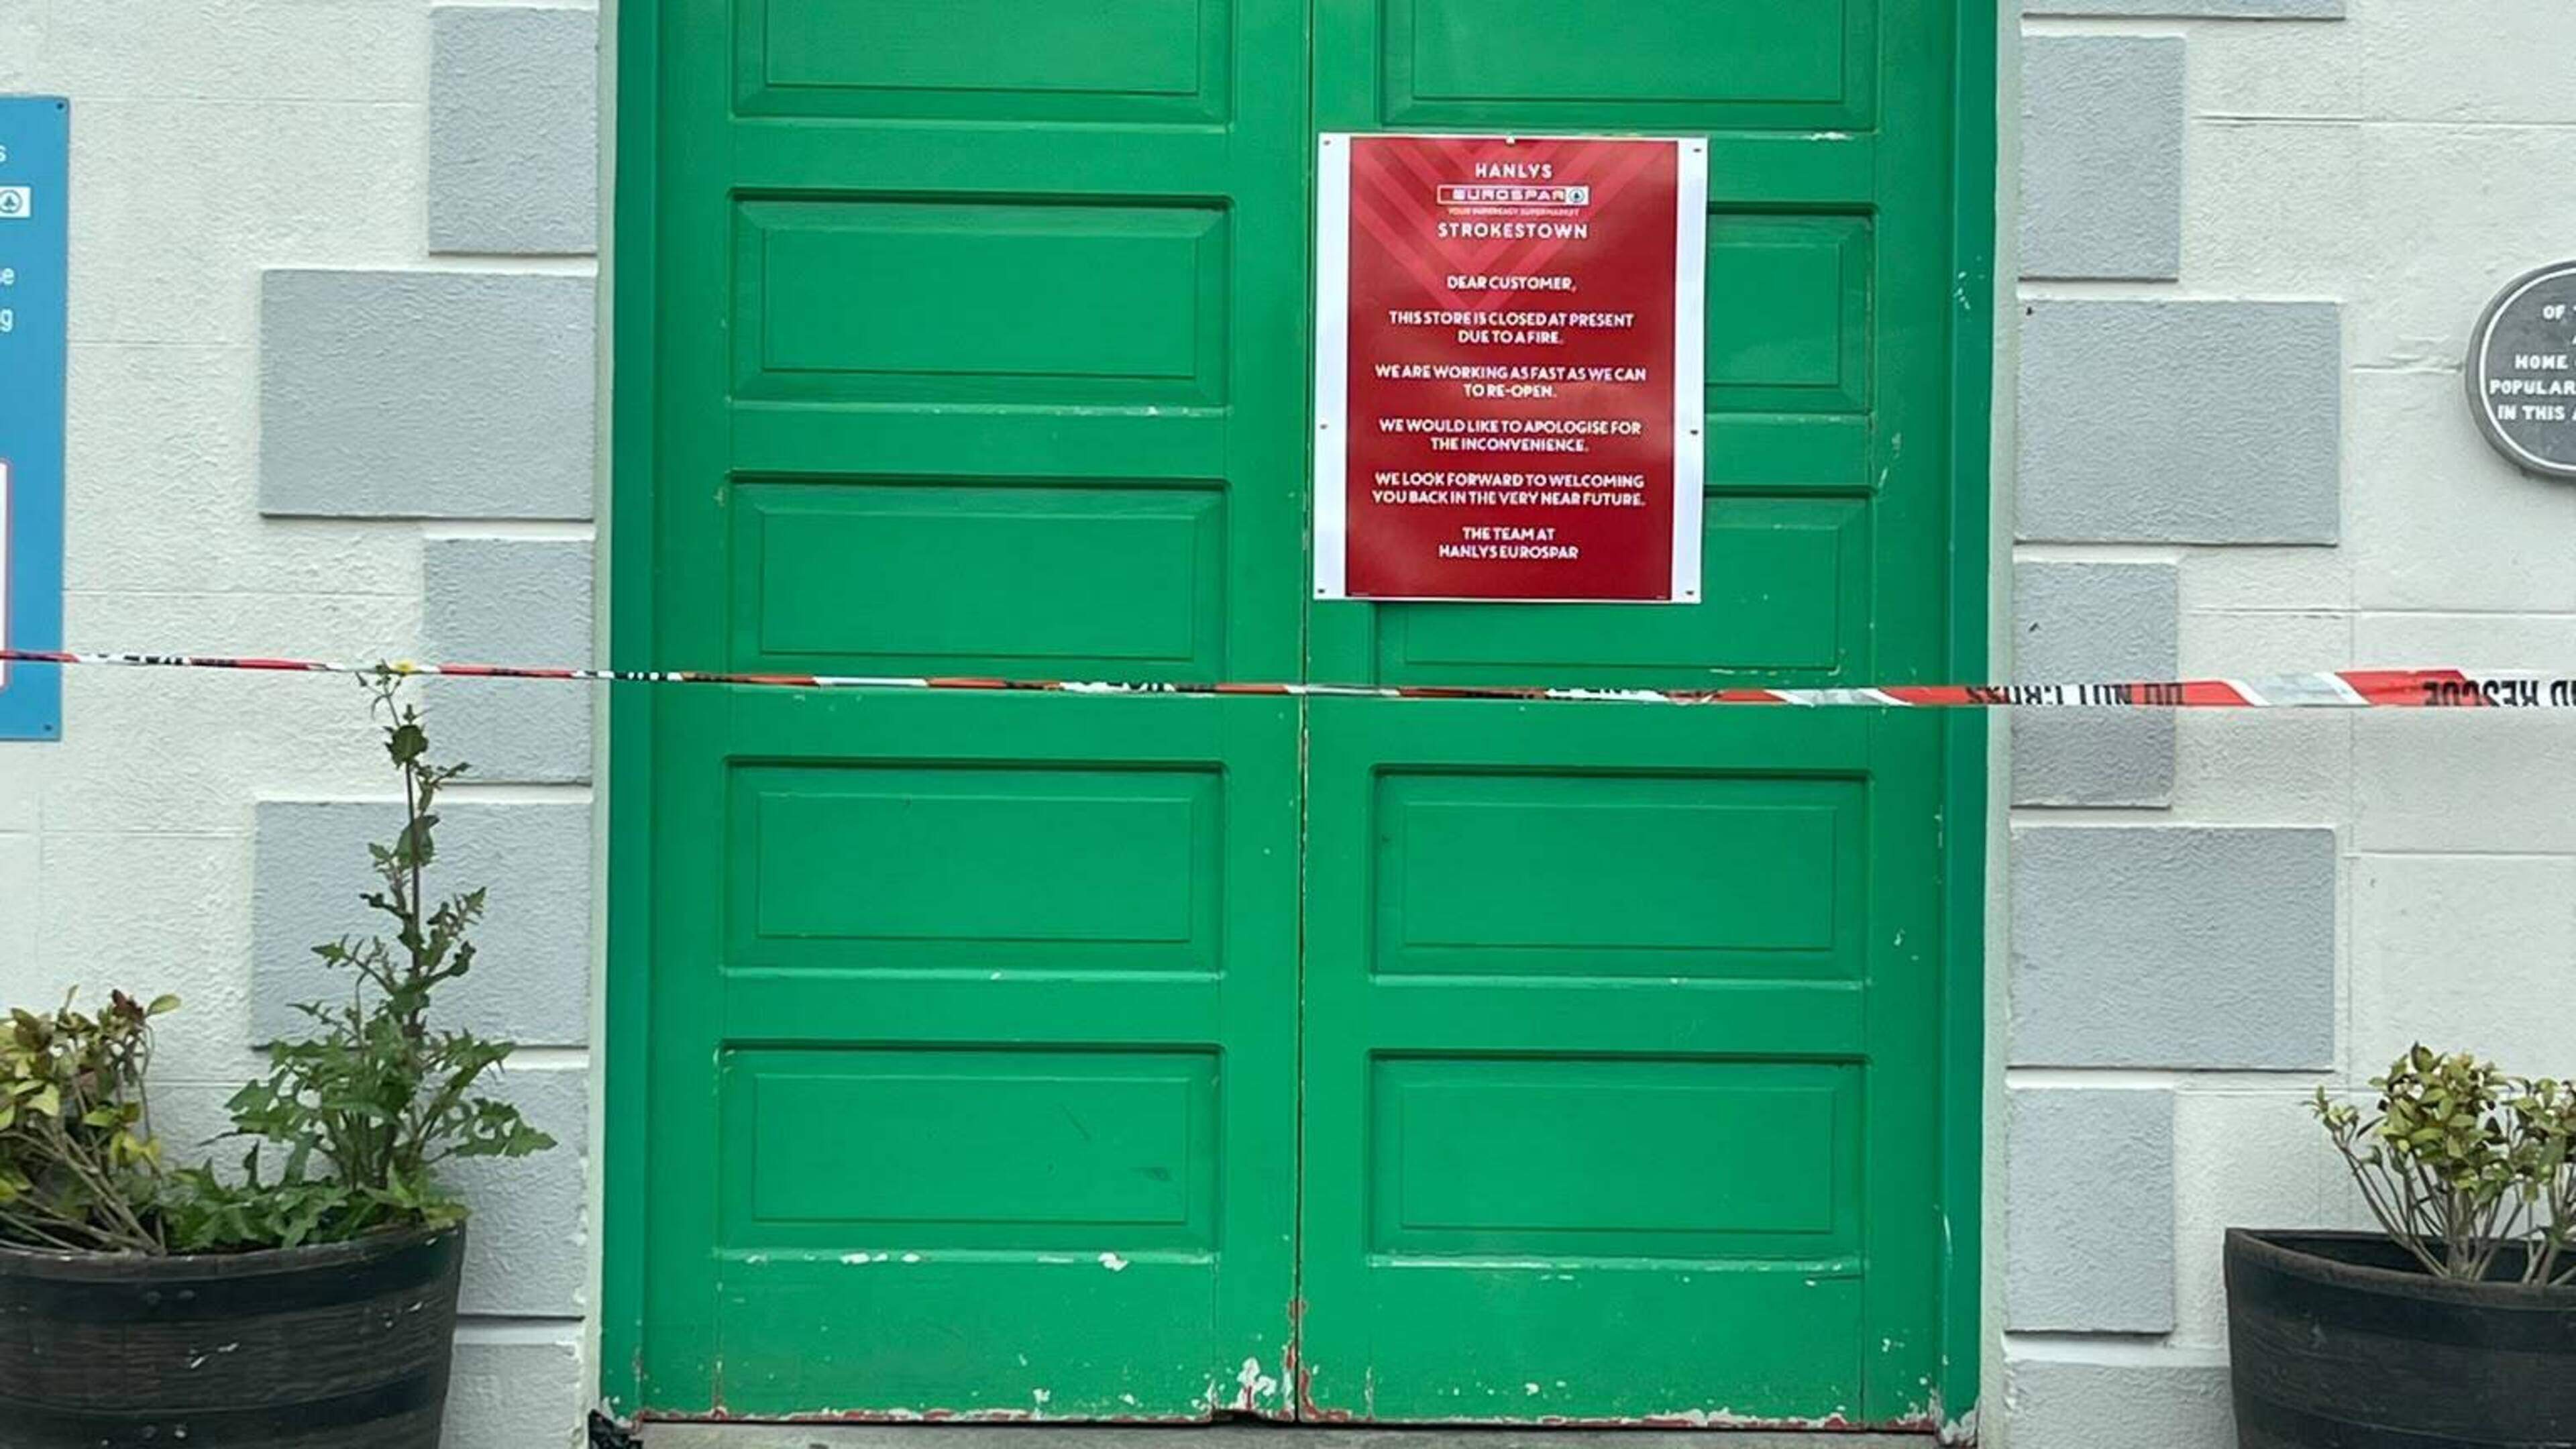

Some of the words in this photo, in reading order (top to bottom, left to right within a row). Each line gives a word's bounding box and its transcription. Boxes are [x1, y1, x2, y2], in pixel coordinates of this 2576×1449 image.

[1475, 164, 1552, 178] HANLYS
[1452, 189, 1565, 201] EUROSPAR
[1437, 222, 1588, 239] STROKESTOWN
[1447, 275, 1487, 289] DEAR
[1389, 311, 1422, 324] THIS
[1424, 311, 1471, 325] STORE
[1473, 312, 1487, 325] IS
[1488, 312, 1547, 326] CLOSED
[1548, 313, 1567, 326] AT
[1569, 313, 1633, 327] PRESENT
[2542, 304, 2566, 320] OF
[1458, 329, 1489, 343] DUE
[1491, 330, 1513, 343] TO
[1514, 331, 1525, 343] A
[2515, 354, 2569, 370] HOME
[1375, 364, 1400, 378] WE
[1401, 365, 1431, 378] ARE
[1433, 365, 1508, 380] WORKING
[1510, 366, 1529, 380] AS
[1530, 366, 1565, 380] FAST
[1567, 367, 1587, 380] AS
[1588, 368, 1612, 381] WE
[1614, 368, 1646, 381] CAN
[1463, 383, 1485, 397] TO
[2489, 379, 2576, 395] POPULAR
[2498, 405, 2516, 421] IN
[2522, 405, 2565, 421] THIS
[1379, 419, 1403, 431] WE
[1406, 419, 1466, 432] WOULD
[1467, 420, 1499, 433] LIKE
[1501, 420, 1522, 433] TO
[1523, 420, 1609, 435] APOLOGISE
[1611, 421, 1642, 435] FOR
[1431, 437, 1458, 450] THE
[1375, 472, 1399, 485] WE
[1402, 472, 1444, 486] LOOK
[1447, 472, 1524, 487] FORWARD
[1525, 474, 1547, 486] TO
[1548, 474, 1644, 488] WELCOMING
[1372, 490, 1407, 503] YOU
[1409, 490, 1448, 504] BACK
[1450, 491, 1466, 504] IN
[1468, 491, 1496, 504] THE
[1499, 491, 1539, 504] VERY
[1541, 492, 1580, 505] NEAR
[1462, 527, 1491, 540] THE
[1493, 527, 1534, 540] TEAM
[1536, 528, 1554, 541] AT
[1439, 545, 1498, 558] HANLYS
[1499, 545, 1578, 559] EUROSPAR
